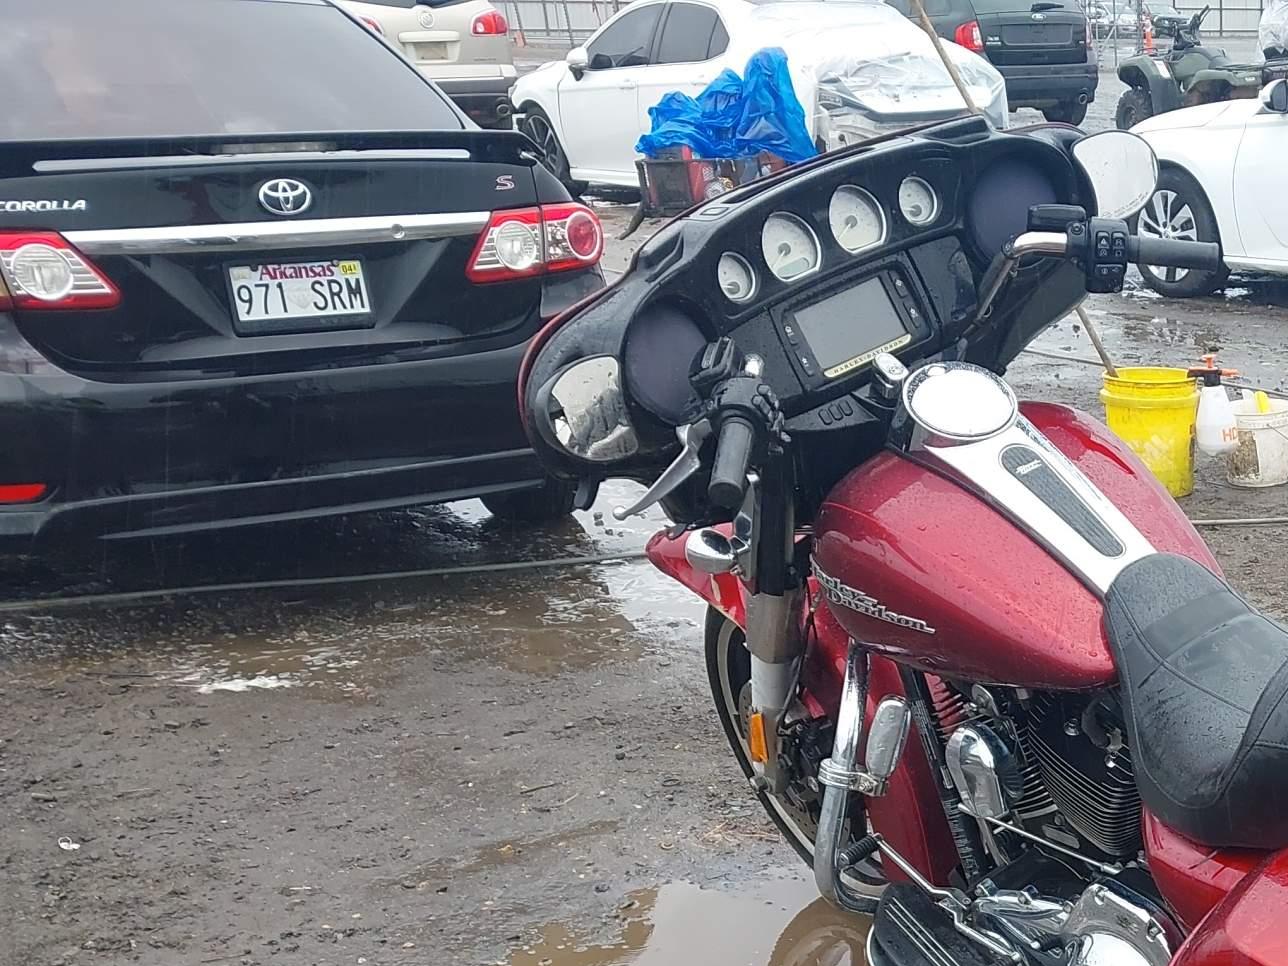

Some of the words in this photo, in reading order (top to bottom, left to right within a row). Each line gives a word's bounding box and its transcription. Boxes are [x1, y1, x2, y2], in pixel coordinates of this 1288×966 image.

[495, 174, 515, 190] S
[259, 263, 335, 281] Arkansas
[237, 281, 289, 316] 971
[311, 277, 366, 311] SRM
